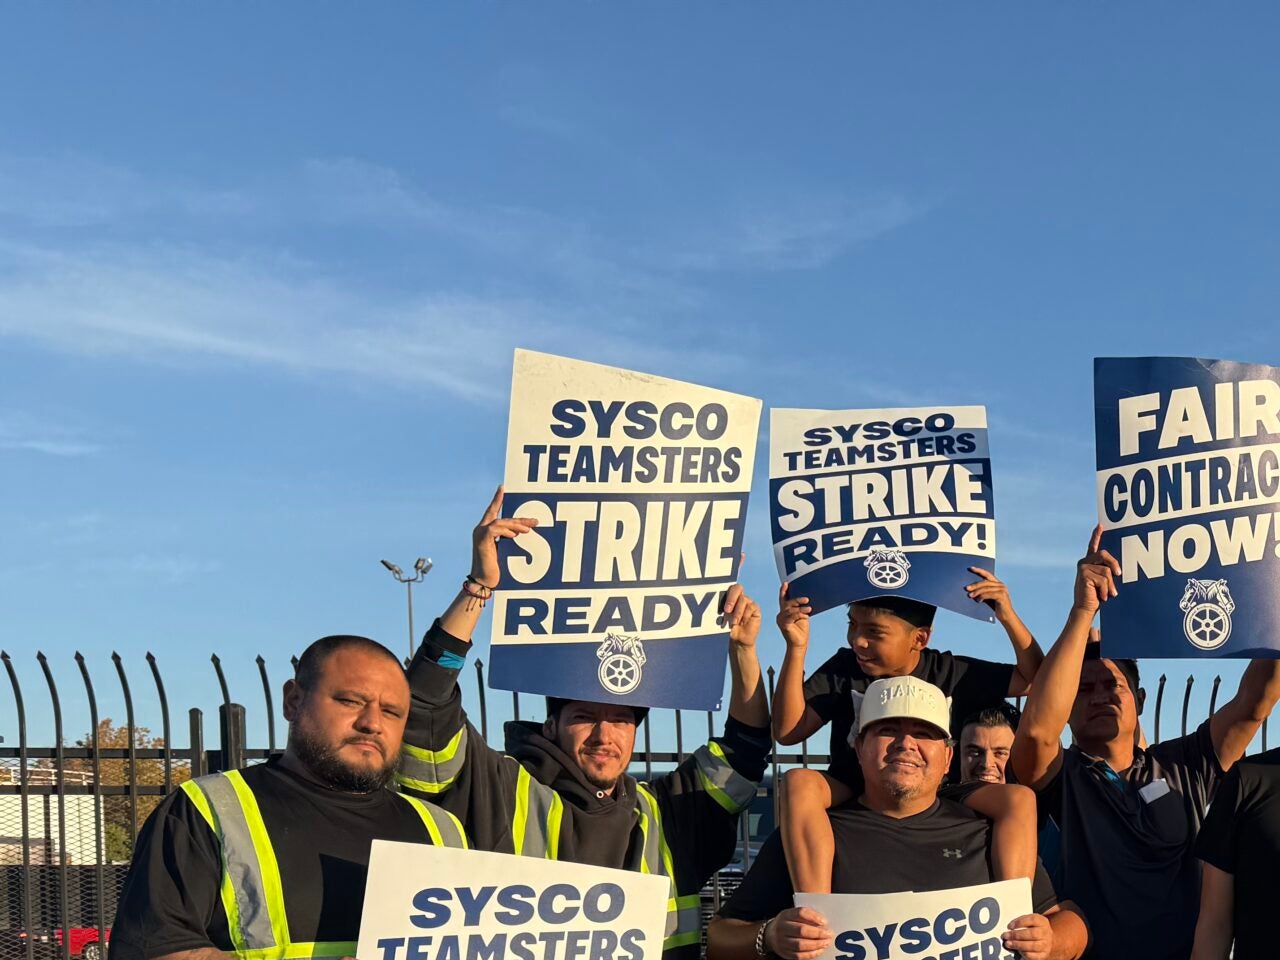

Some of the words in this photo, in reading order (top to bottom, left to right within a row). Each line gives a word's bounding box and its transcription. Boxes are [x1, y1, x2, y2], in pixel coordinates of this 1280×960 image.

[550, 399, 728, 441] SYSCO
[803, 413, 955, 447] SYSCO
[523, 444, 742, 484] TEAMSTERS
[783, 432, 977, 472] TEAMSTERS
[777, 463, 987, 532] STRIKE
[507, 499, 743, 584] STRIKE
[782, 521, 987, 576] READY!
[410, 882, 626, 929] SYSCO
